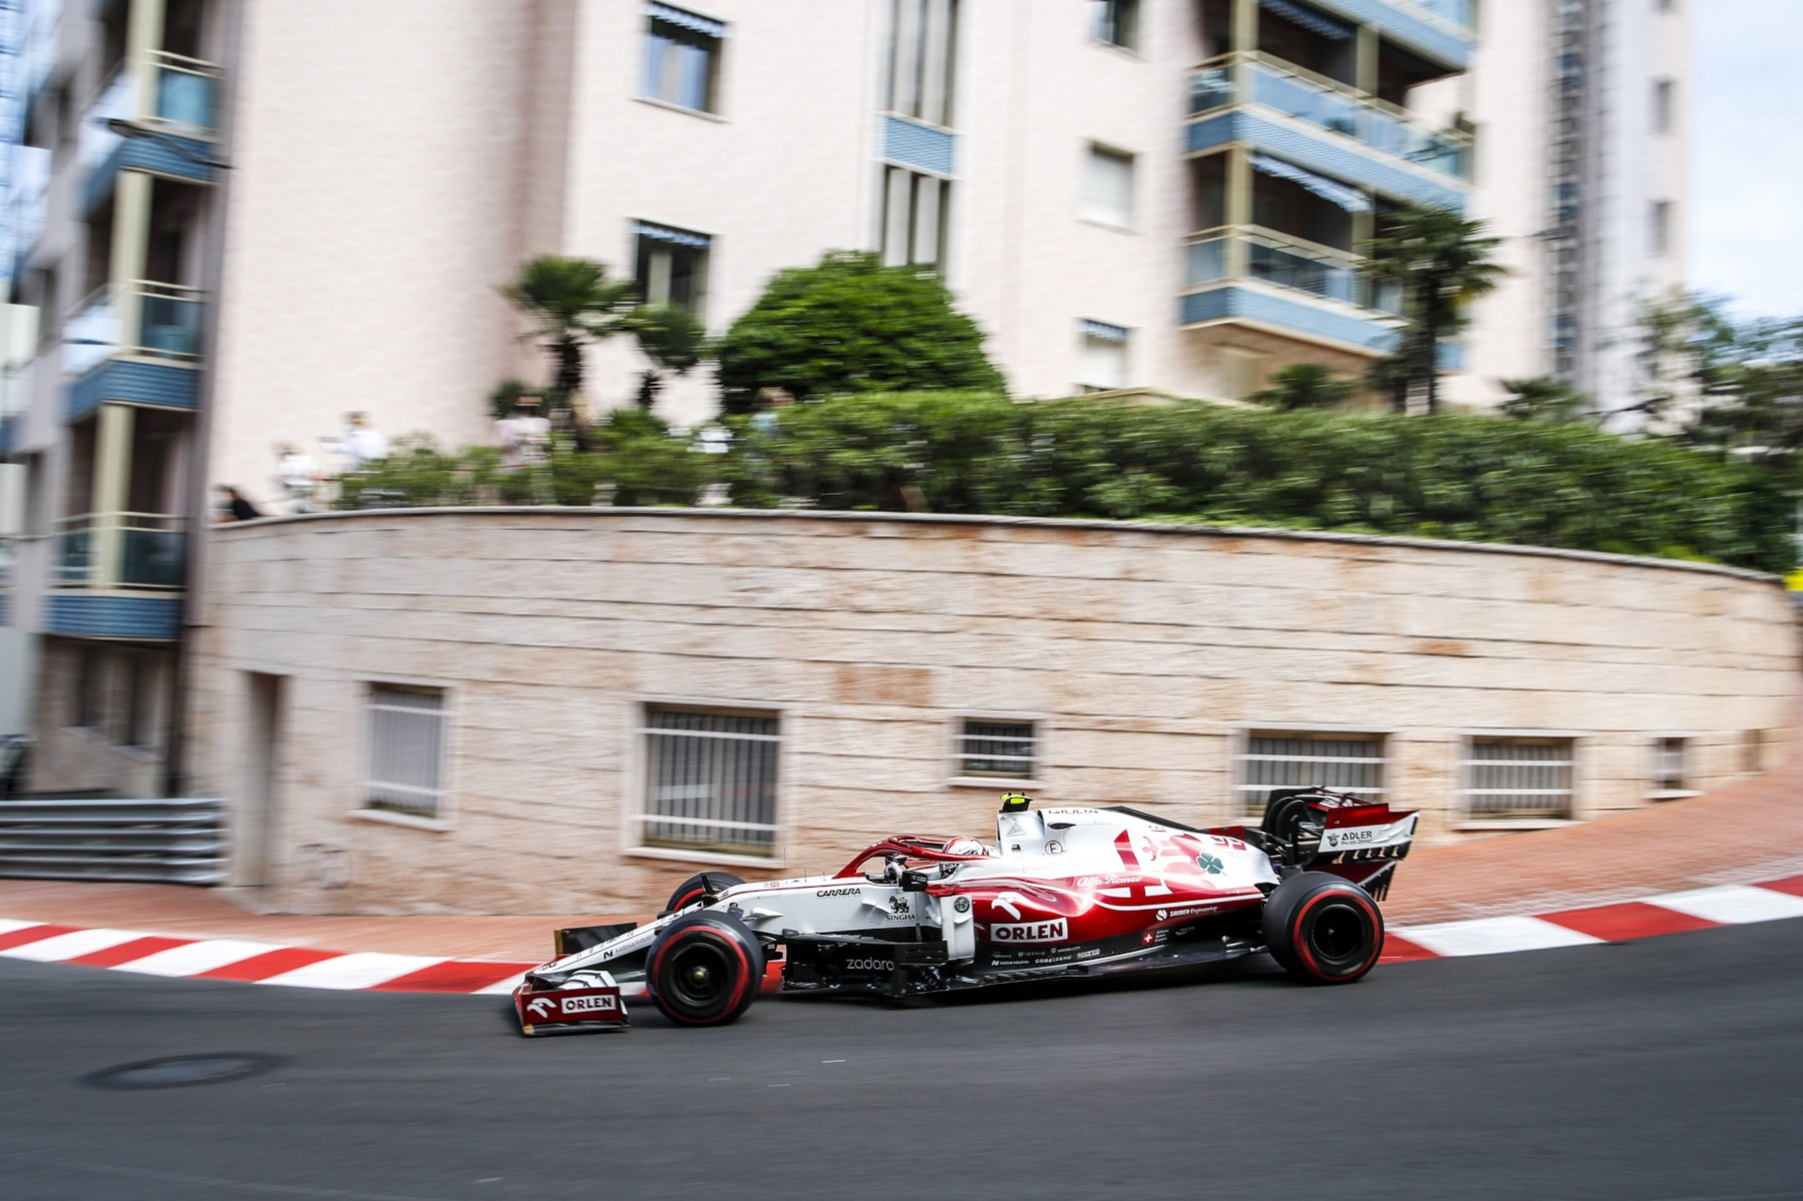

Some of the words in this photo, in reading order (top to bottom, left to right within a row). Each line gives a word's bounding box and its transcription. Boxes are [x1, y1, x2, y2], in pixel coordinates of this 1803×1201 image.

[1341, 830, 1373, 841] ADLER
[1076, 876, 1103, 889] Alfa
[1104, 873, 1143, 885] Romeo
[816, 888, 861, 897] CARRERA
[885, 914, 916, 922] SINGHA
[1169, 908, 1190, 918] SAUBER
[1190, 906, 1218, 914] Engineering
[995, 922, 1063, 940] ORLEN
[565, 997, 612, 1011] ORLEN
